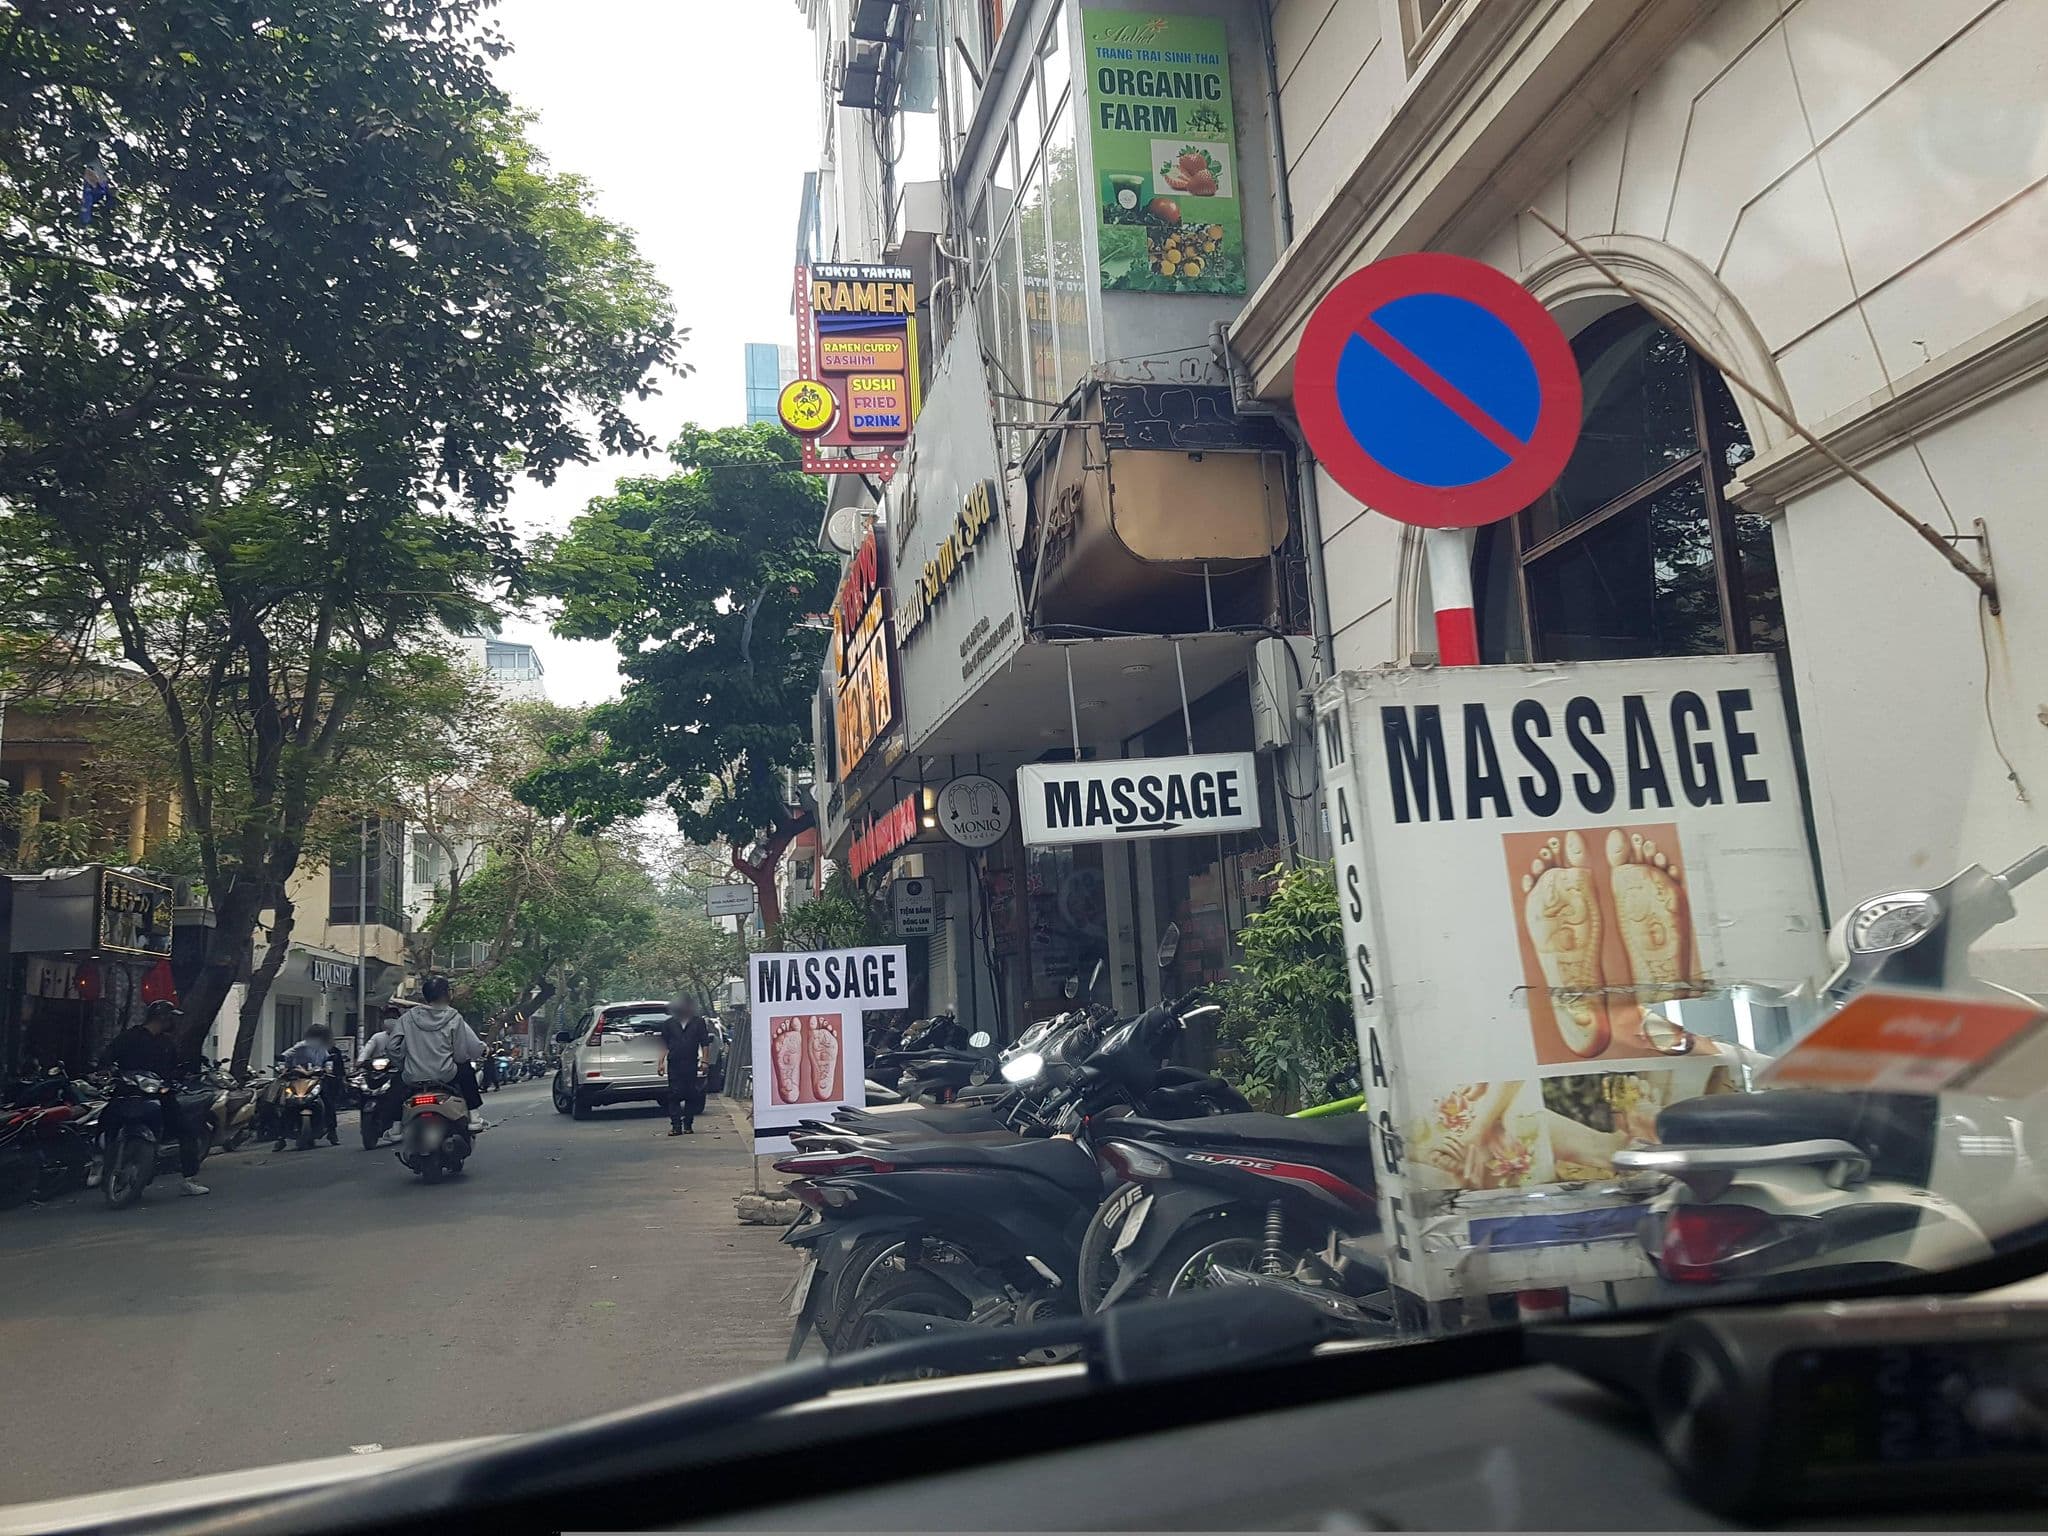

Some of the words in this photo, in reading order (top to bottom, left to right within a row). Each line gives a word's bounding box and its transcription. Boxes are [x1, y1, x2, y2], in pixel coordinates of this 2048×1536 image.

[1095, 47, 1132, 60] TRANG
[1165, 52, 1192, 64] SINH
[1097, 67, 1221, 101] ORGANIC
[1100, 102, 1178, 133] FARM
[816, 266, 857, 279] TOKYO
[861, 266, 911, 279] TANTAN
[813, 281, 915, 313] RAMEN
[823, 343, 860, 352] RAMEN
[863, 343, 899, 353] CURRY
[825, 355, 875, 366] SASHIMI
[852, 378, 896, 392] SUSHI
[853, 396, 896, 410] FRIED
[853, 414, 900, 428] DRINK
[1380, 688, 1771, 824] MASSAGE
[1043, 770, 1242, 829] MASSAGE
[953, 818, 1001, 835] MONIQ
[758, 954, 898, 1003] MASSAGE
[1184, 1153, 1275, 1171] BLADE
